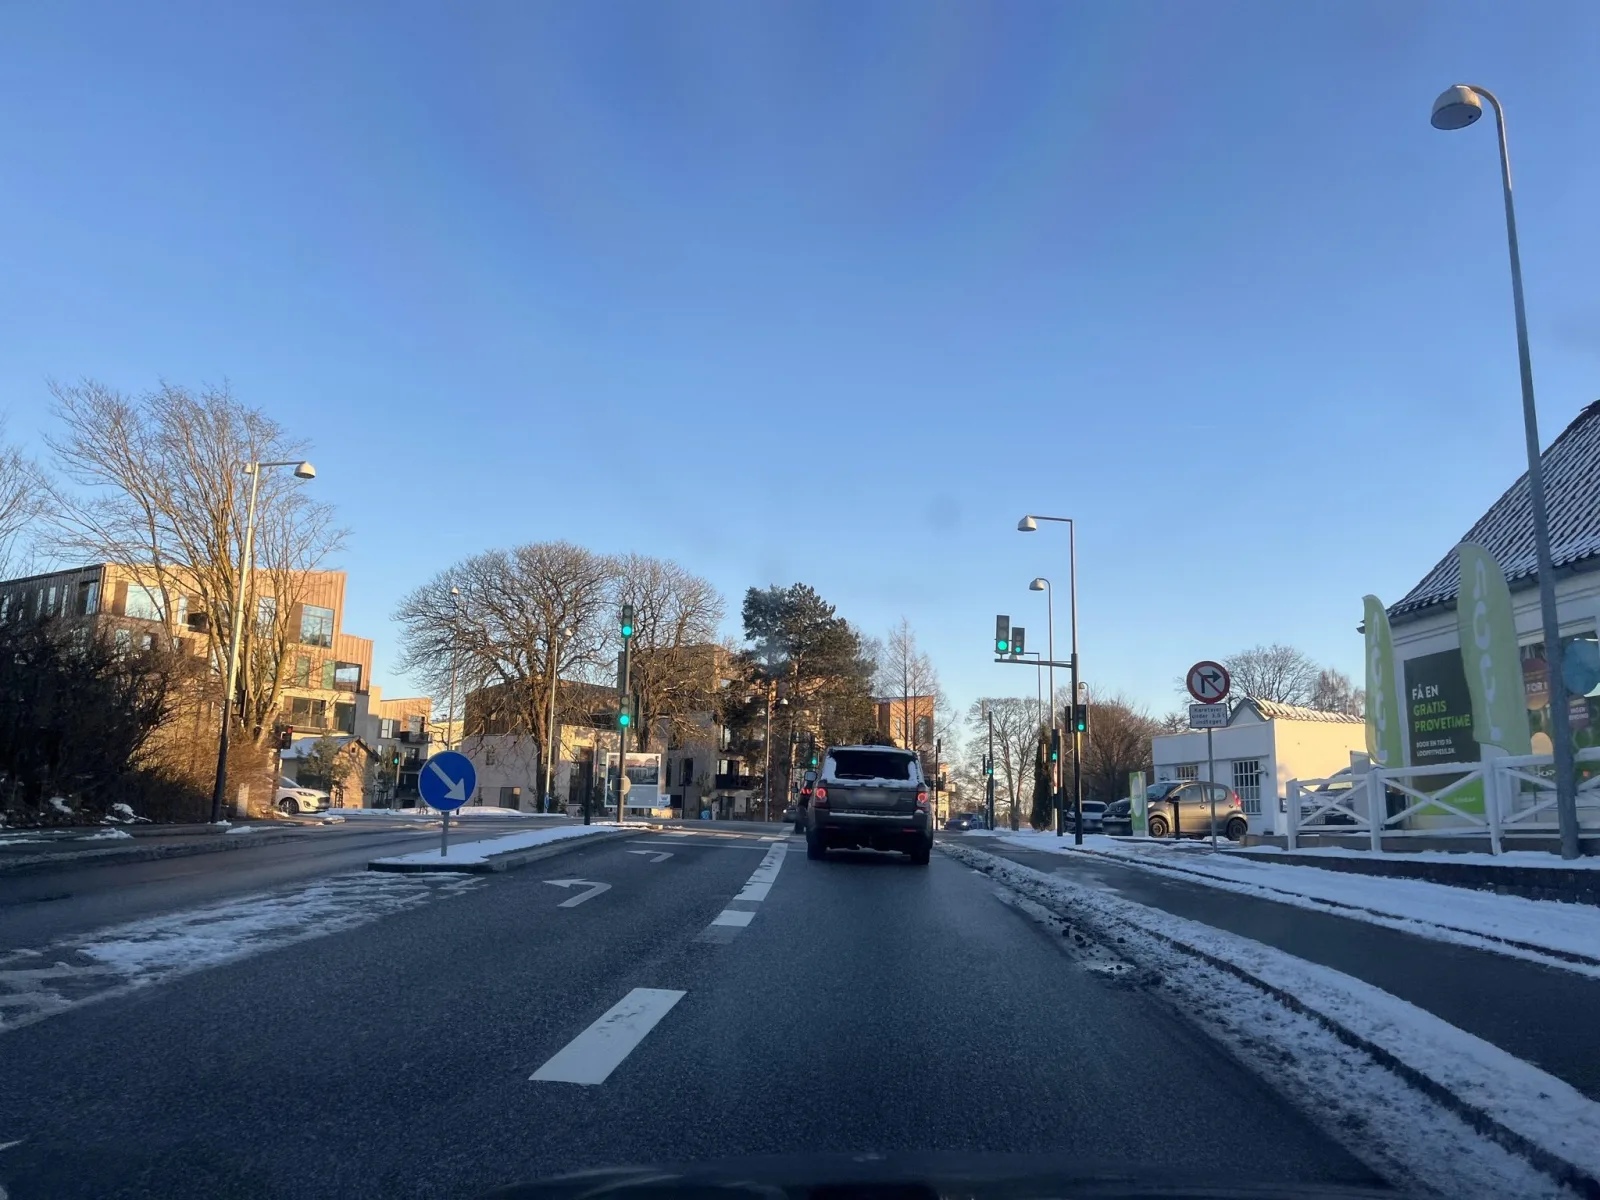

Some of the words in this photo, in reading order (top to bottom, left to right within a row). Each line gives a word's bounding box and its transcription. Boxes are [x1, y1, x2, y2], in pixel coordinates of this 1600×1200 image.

[1412, 684, 1424, 700] FÅ
[1425, 685, 1438, 698] EN
[1413, 701, 1447, 716] GRATIS
[1415, 714, 1471, 732] PRØVETIME
